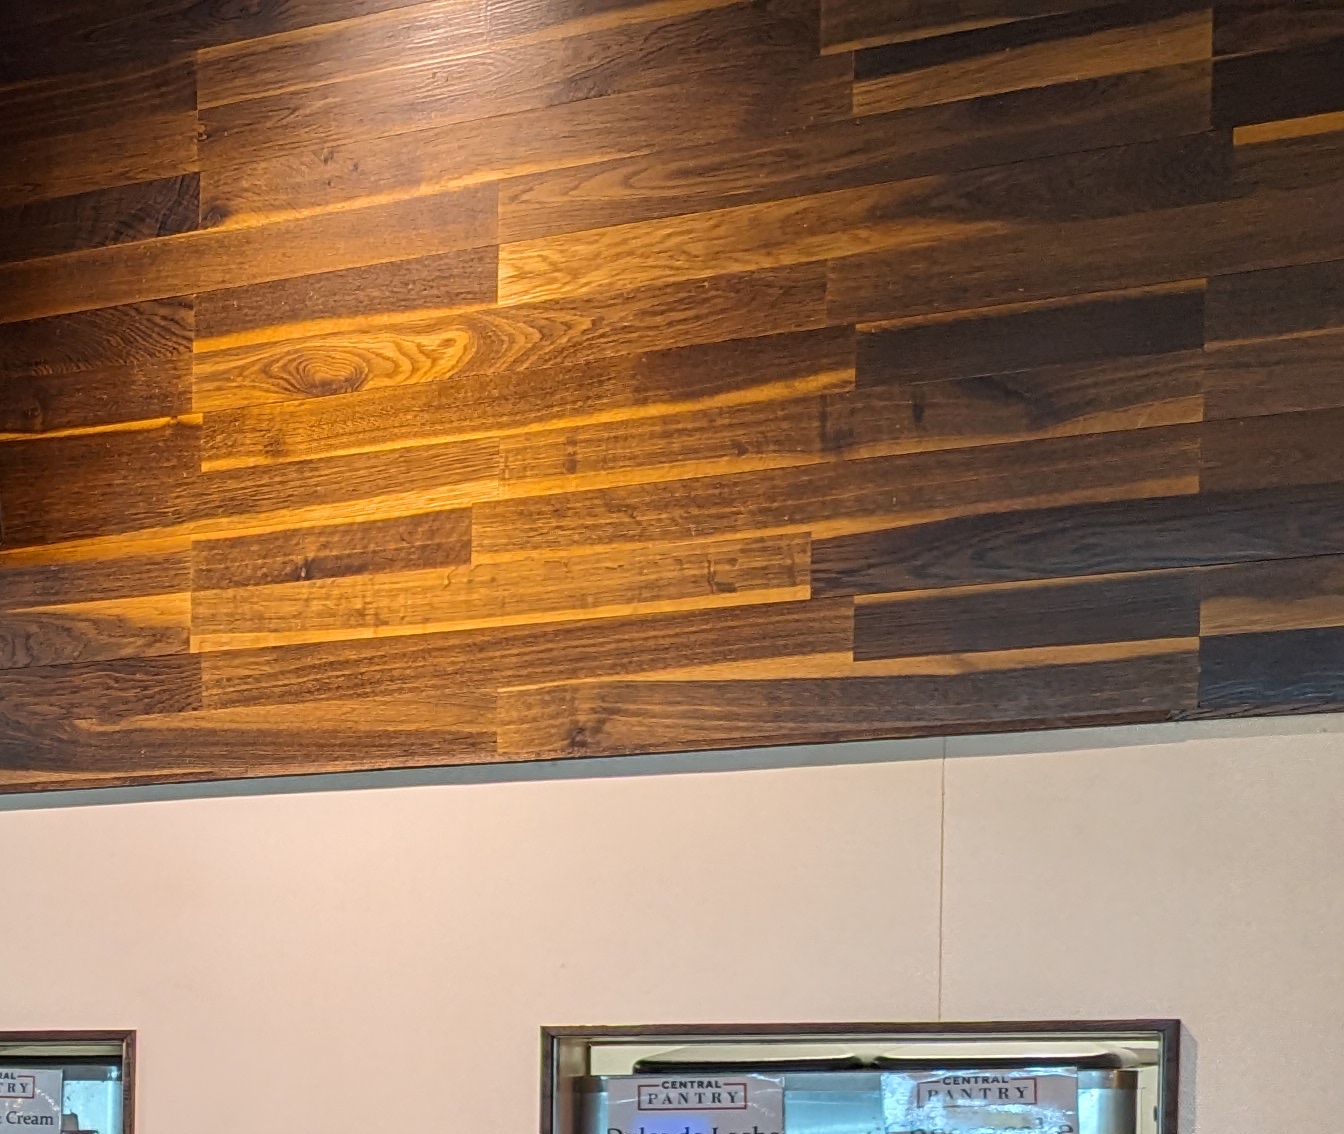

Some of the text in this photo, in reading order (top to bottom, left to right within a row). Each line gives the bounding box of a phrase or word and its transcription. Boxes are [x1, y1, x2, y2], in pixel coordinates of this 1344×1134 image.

[662, 1081, 722, 1089] CENTRAL
[942, 1076, 1009, 1085] CENTRAL
[648, 1092, 738, 1104] PANTRY
[927, 1086, 1029, 1101] PANTRY
[6, 1111, 54, 1125] Cream
